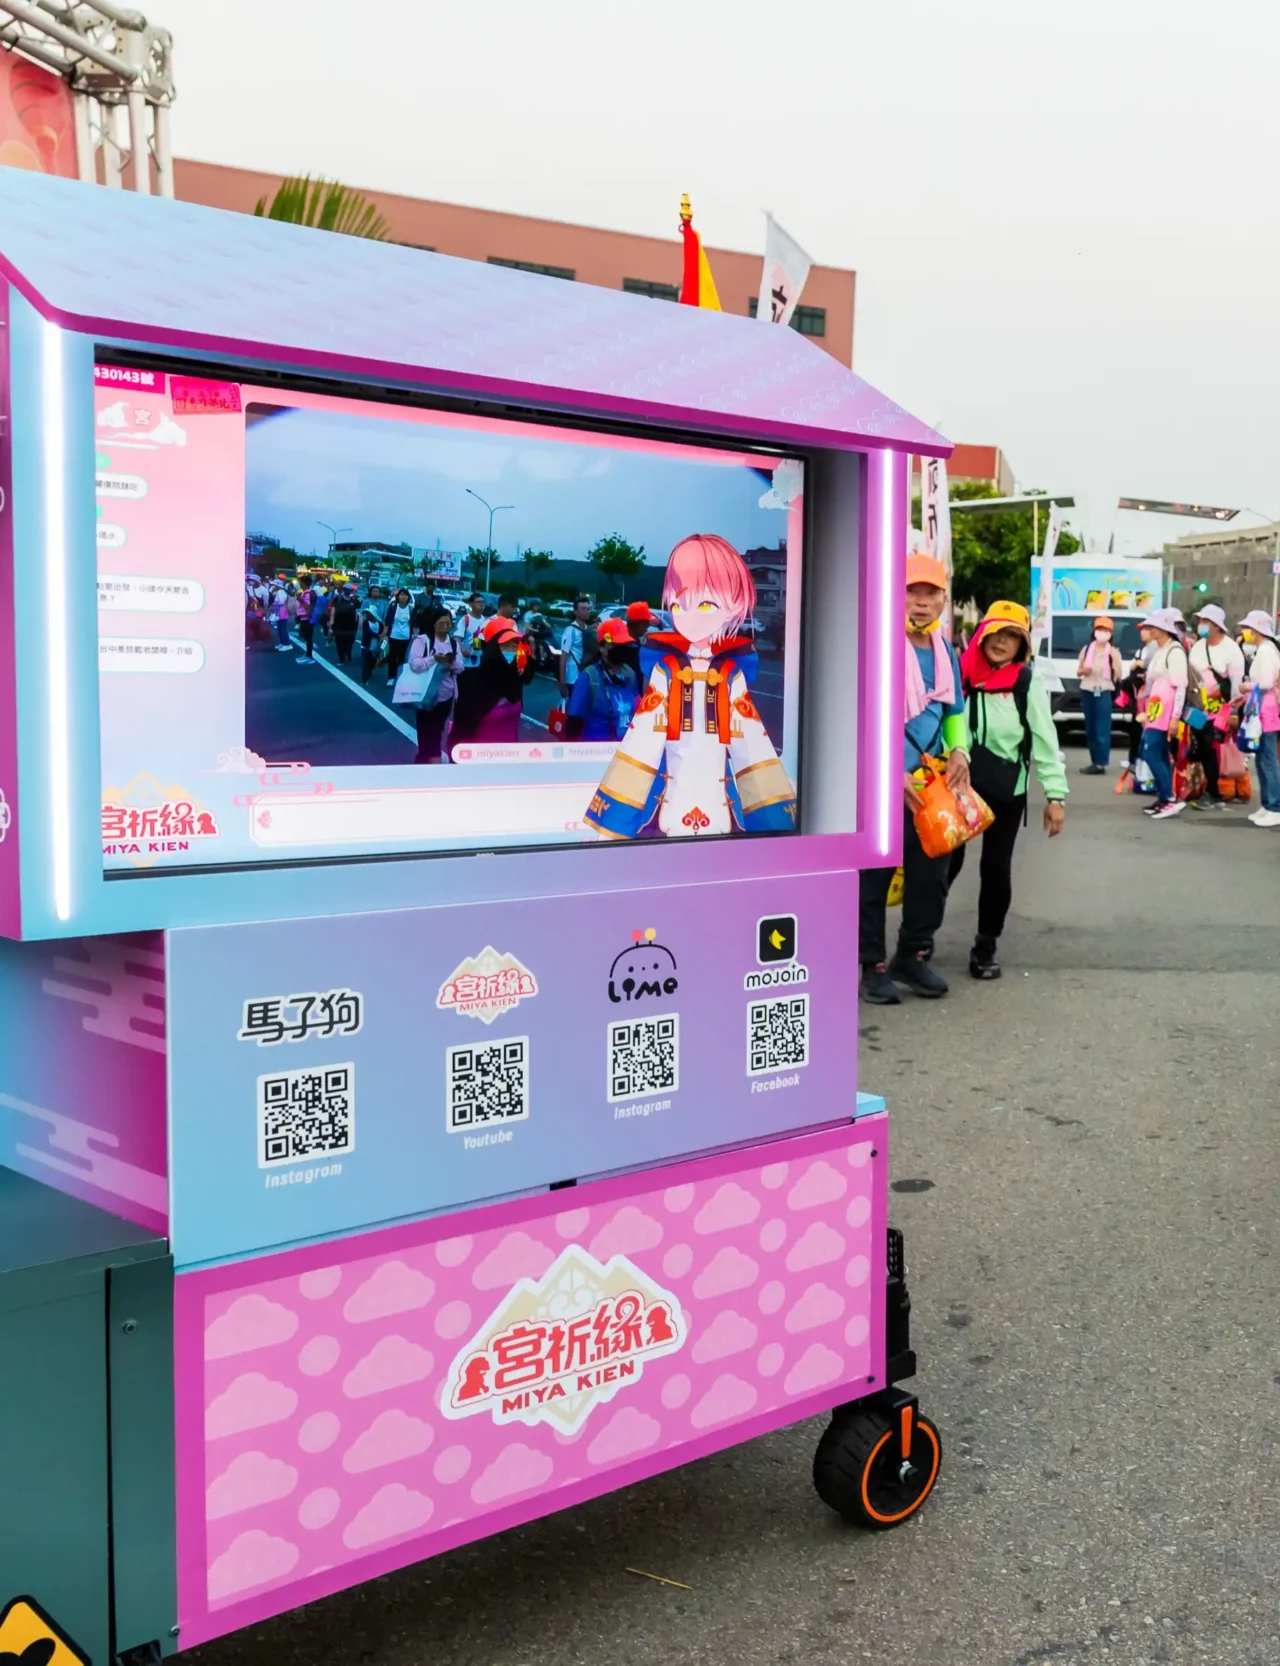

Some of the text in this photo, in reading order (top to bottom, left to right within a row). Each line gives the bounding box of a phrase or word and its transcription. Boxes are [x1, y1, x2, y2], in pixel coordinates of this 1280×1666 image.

[148, 841, 189, 852] KIEN
[455, 969, 520, 1001] 宮祈緣
[460, 997, 517, 1011] MIYA KIEN
[751, 1073, 800, 1094] Facebook
[614, 1100, 671, 1120] Instagram
[463, 1130, 513, 1150] Youtube
[265, 1163, 342, 1189] Instagram
[493, 1295, 643, 1390] 宮祈緣
[502, 1360, 634, 1414] MIYA KIEN
